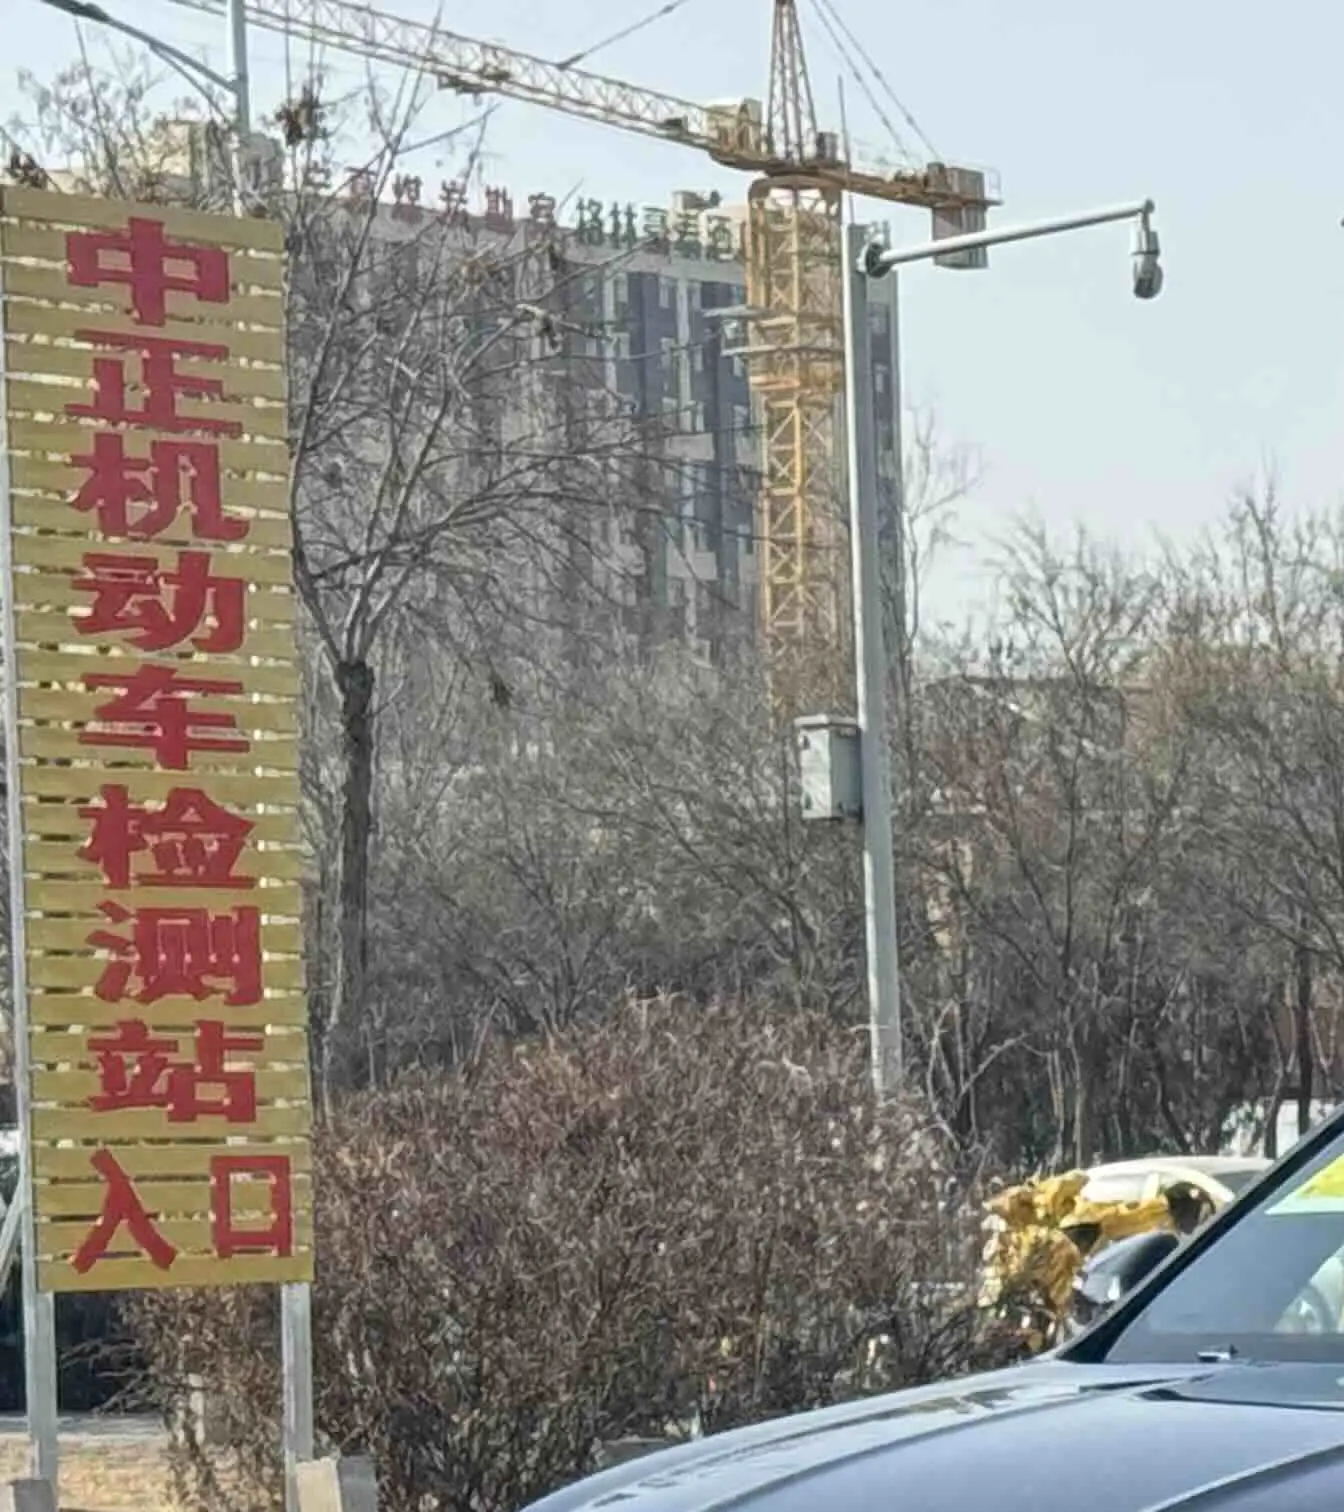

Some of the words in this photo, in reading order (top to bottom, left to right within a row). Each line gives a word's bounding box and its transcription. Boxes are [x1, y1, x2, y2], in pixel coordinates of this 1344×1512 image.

[66, 217, 262, 1125] 中正机动车检测站
[72, 1150, 293, 1274] 入口
